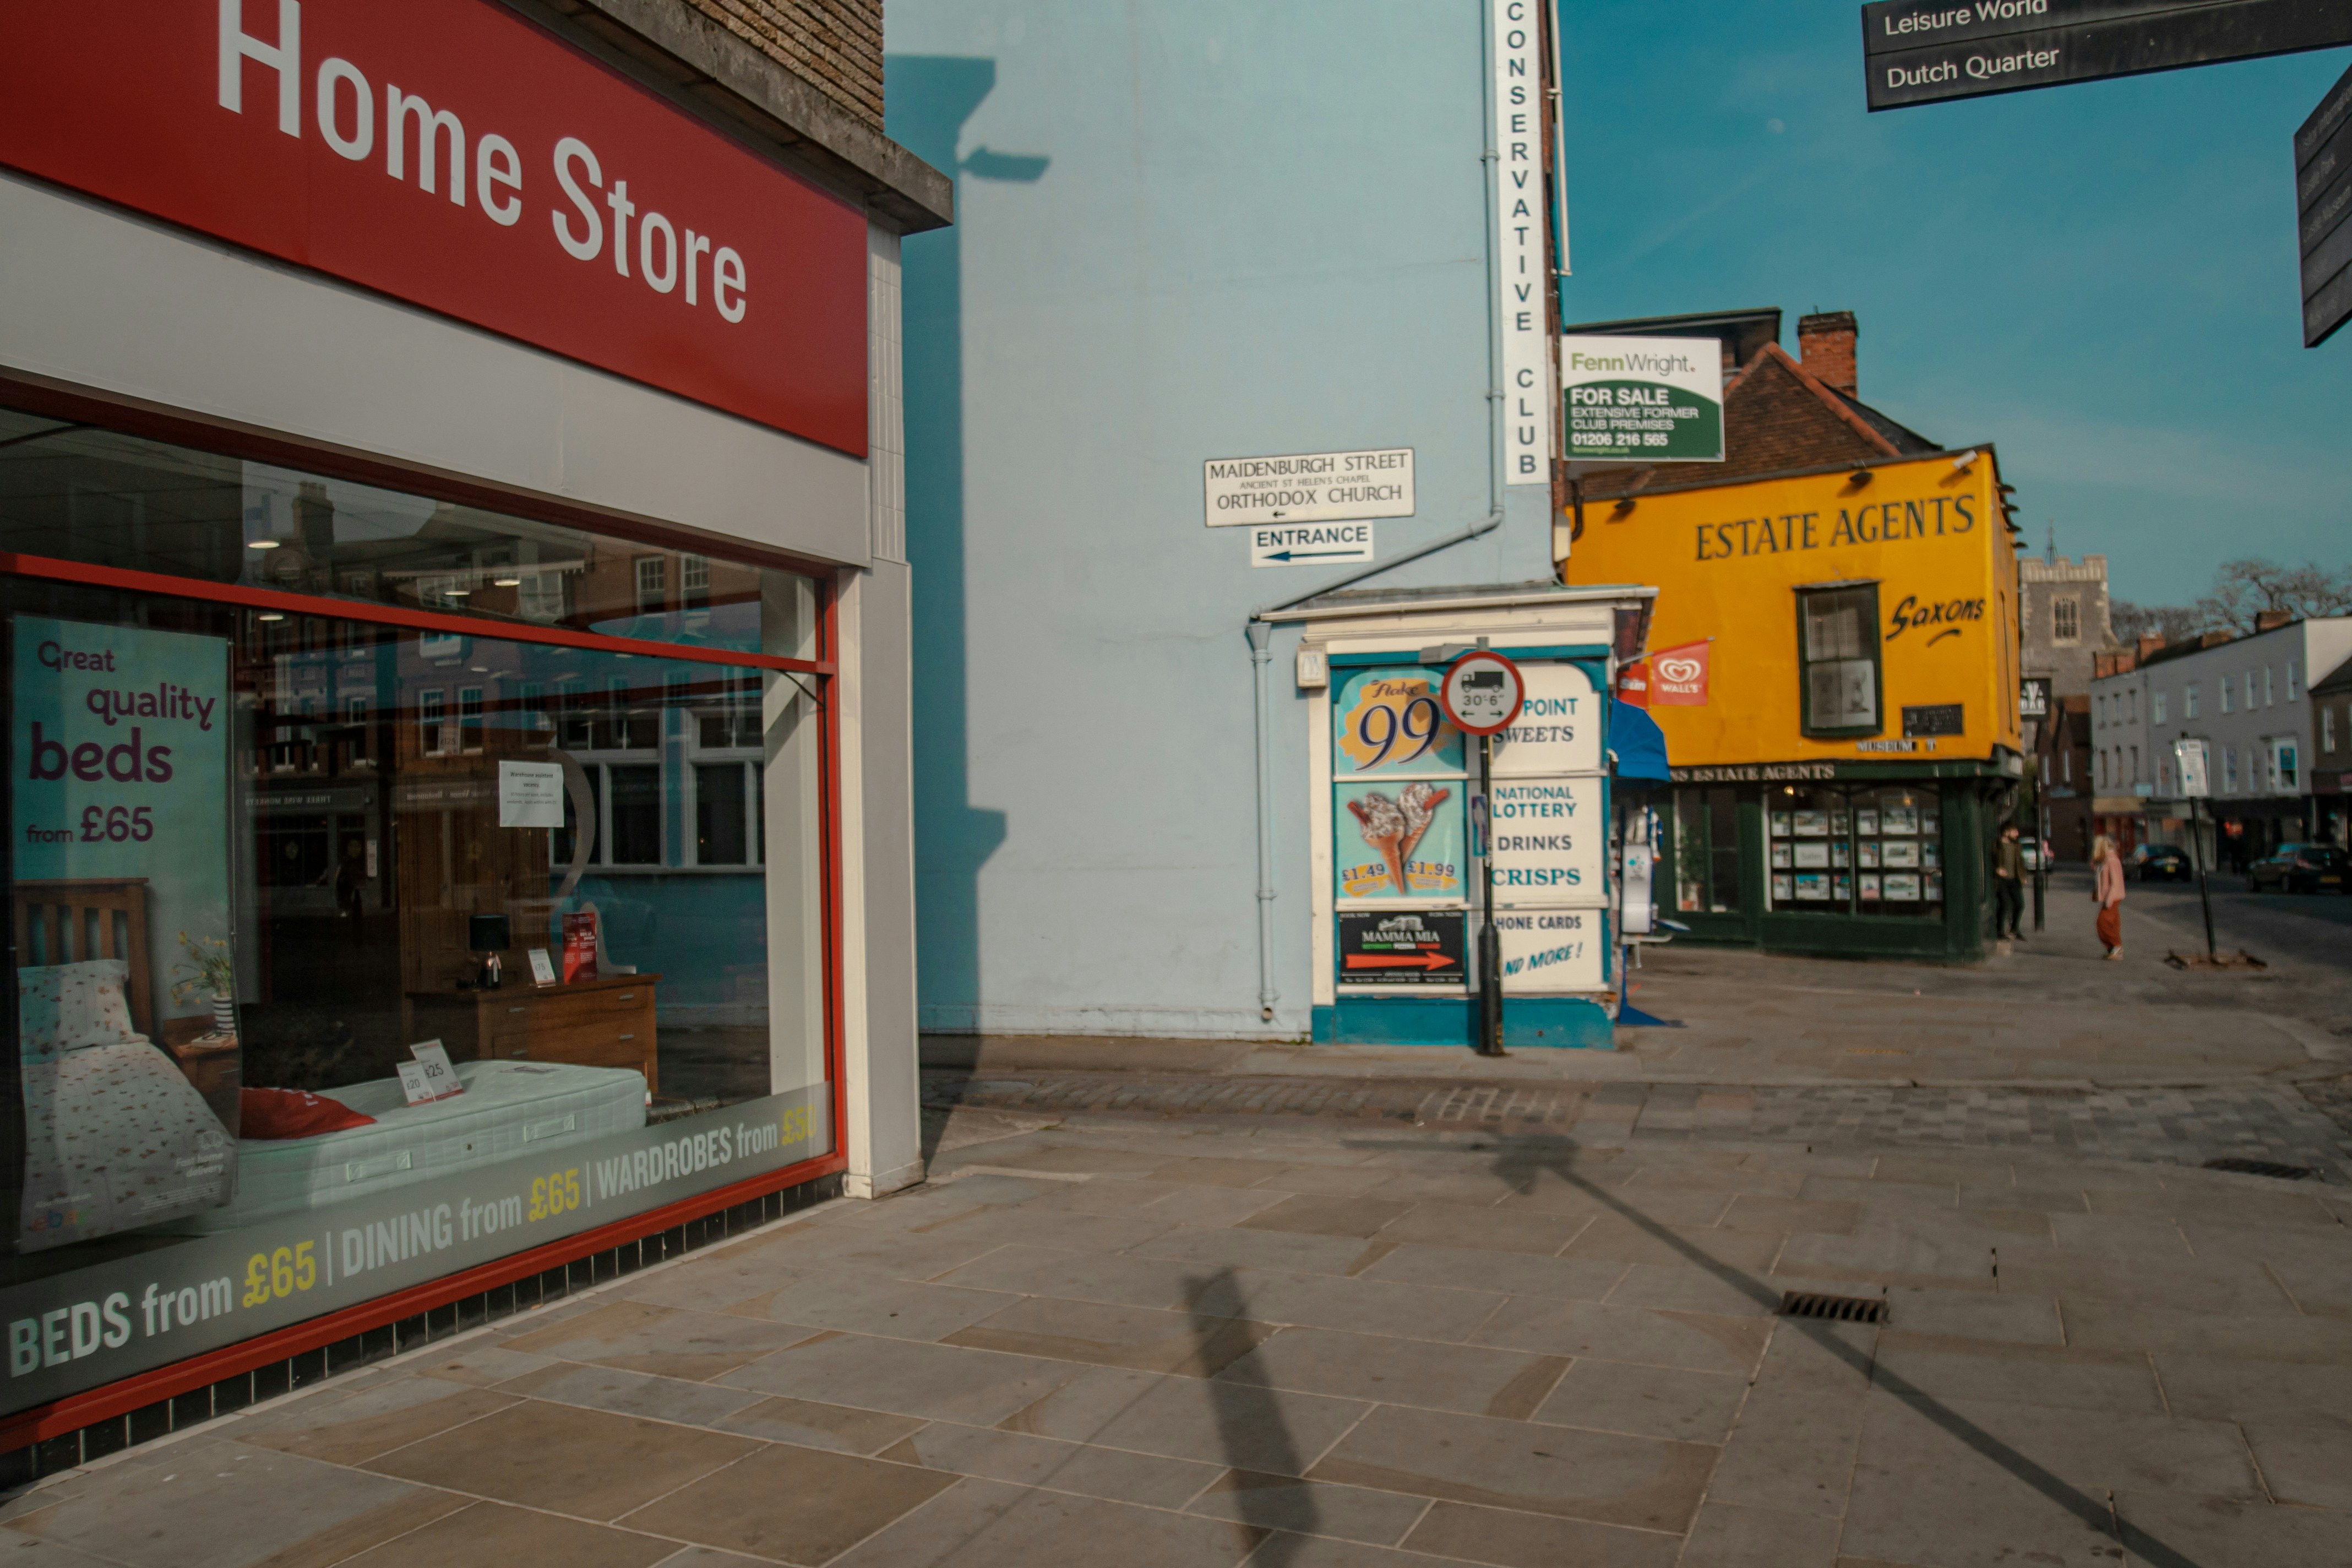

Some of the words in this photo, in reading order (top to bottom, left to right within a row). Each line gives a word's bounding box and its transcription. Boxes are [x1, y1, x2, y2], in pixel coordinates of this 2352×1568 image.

[1885, 8, 1971, 36] Leisure
[1975, 0, 2048, 23] World
[1887, 61, 1958, 89] Dutch
[1965, 49, 2060, 79] Quarter
[219, 0, 522, 226] Home
[552, 137, 746, 323] Store
[1507, 2, 1532, 331] CONSERVATIVE
[1571, 388, 1613, 405] FOR
[1617, 389, 1669, 406] SALE
[1517, 368, 1537, 474] CLUB
[1571, 407, 1641, 418] EXTENSIVE
[1644, 407, 1700, 418] FORMER
[1571, 418, 1608, 430] CLUB
[1610, 419, 1675, 431] PREMISES
[1571, 433, 1613, 446] 01206
[1615, 433, 1641, 446] 216
[1643, 433, 1669, 447] 565
[1210, 458, 1335, 480] MAIDENBURGH
[1345, 453, 1408, 471] STREET
[1240, 480, 1278, 489] ANCIENT
[1283, 478, 1292, 488] ST
[1298, 476, 1333, 487] HELEN'S
[1336, 475, 1370, 484] CHAPEL
[1217, 489, 1317, 510] ORTHODOX
[1328, 484, 1402, 503] CHURCH
[1257, 526, 1368, 547] ENTRANCE
[1695, 513, 1819, 562] ESTATE
[1829, 494, 1976, 546] AGENTS
[1886, 594, 1986, 641] Saxons
[37, 640, 116, 673] Great
[1661, 684, 1698, 693] WALL'S
[87, 682, 216, 731] quality
[1523, 698, 1578, 716] POINT
[1354, 698, 1441, 772] 99
[1493, 726, 1574, 743] SWEETS
[29, 721, 173, 783] beds
[1856, 739, 1913, 752] MUSEUM
[1692, 766, 1758, 782] ESTATE
[1762, 763, 1834, 780] AGENTS
[1496, 787, 1574, 800] NATIONAL
[1493, 802, 1578, 819] LOTTERY
[26, 824, 73, 843] from
[80, 805, 154, 842] £65
[1498, 835, 1572, 852] DRINKS
[1342, 864, 1385, 881] £1.49
[1407, 861, 1455, 877] £1.99
[1491, 868, 1581, 886] CRISPS
[1496, 916, 1533, 930] HONE
[1538, 916, 1582, 930] CARDS
[1362, 930, 1413, 941] MAMMA
[1415, 930, 1440, 941] MIA
[1504, 957, 1524, 977] ND
[407, 1079, 420, 1090] £20
[426, 1064, 444, 1078] £25
[9, 1291, 132, 1377] BEDS
[141, 1275, 232, 1337] from
[242, 1240, 316, 1308] £65
[342, 1203, 453, 1277] DINING
[460, 1194, 522, 1244] from
[529, 1168, 579, 1222] £65
[596, 1127, 732, 1200] WARDROBES
[736, 1121, 778, 1159] from
[782, 1103, 816, 1146] £50
